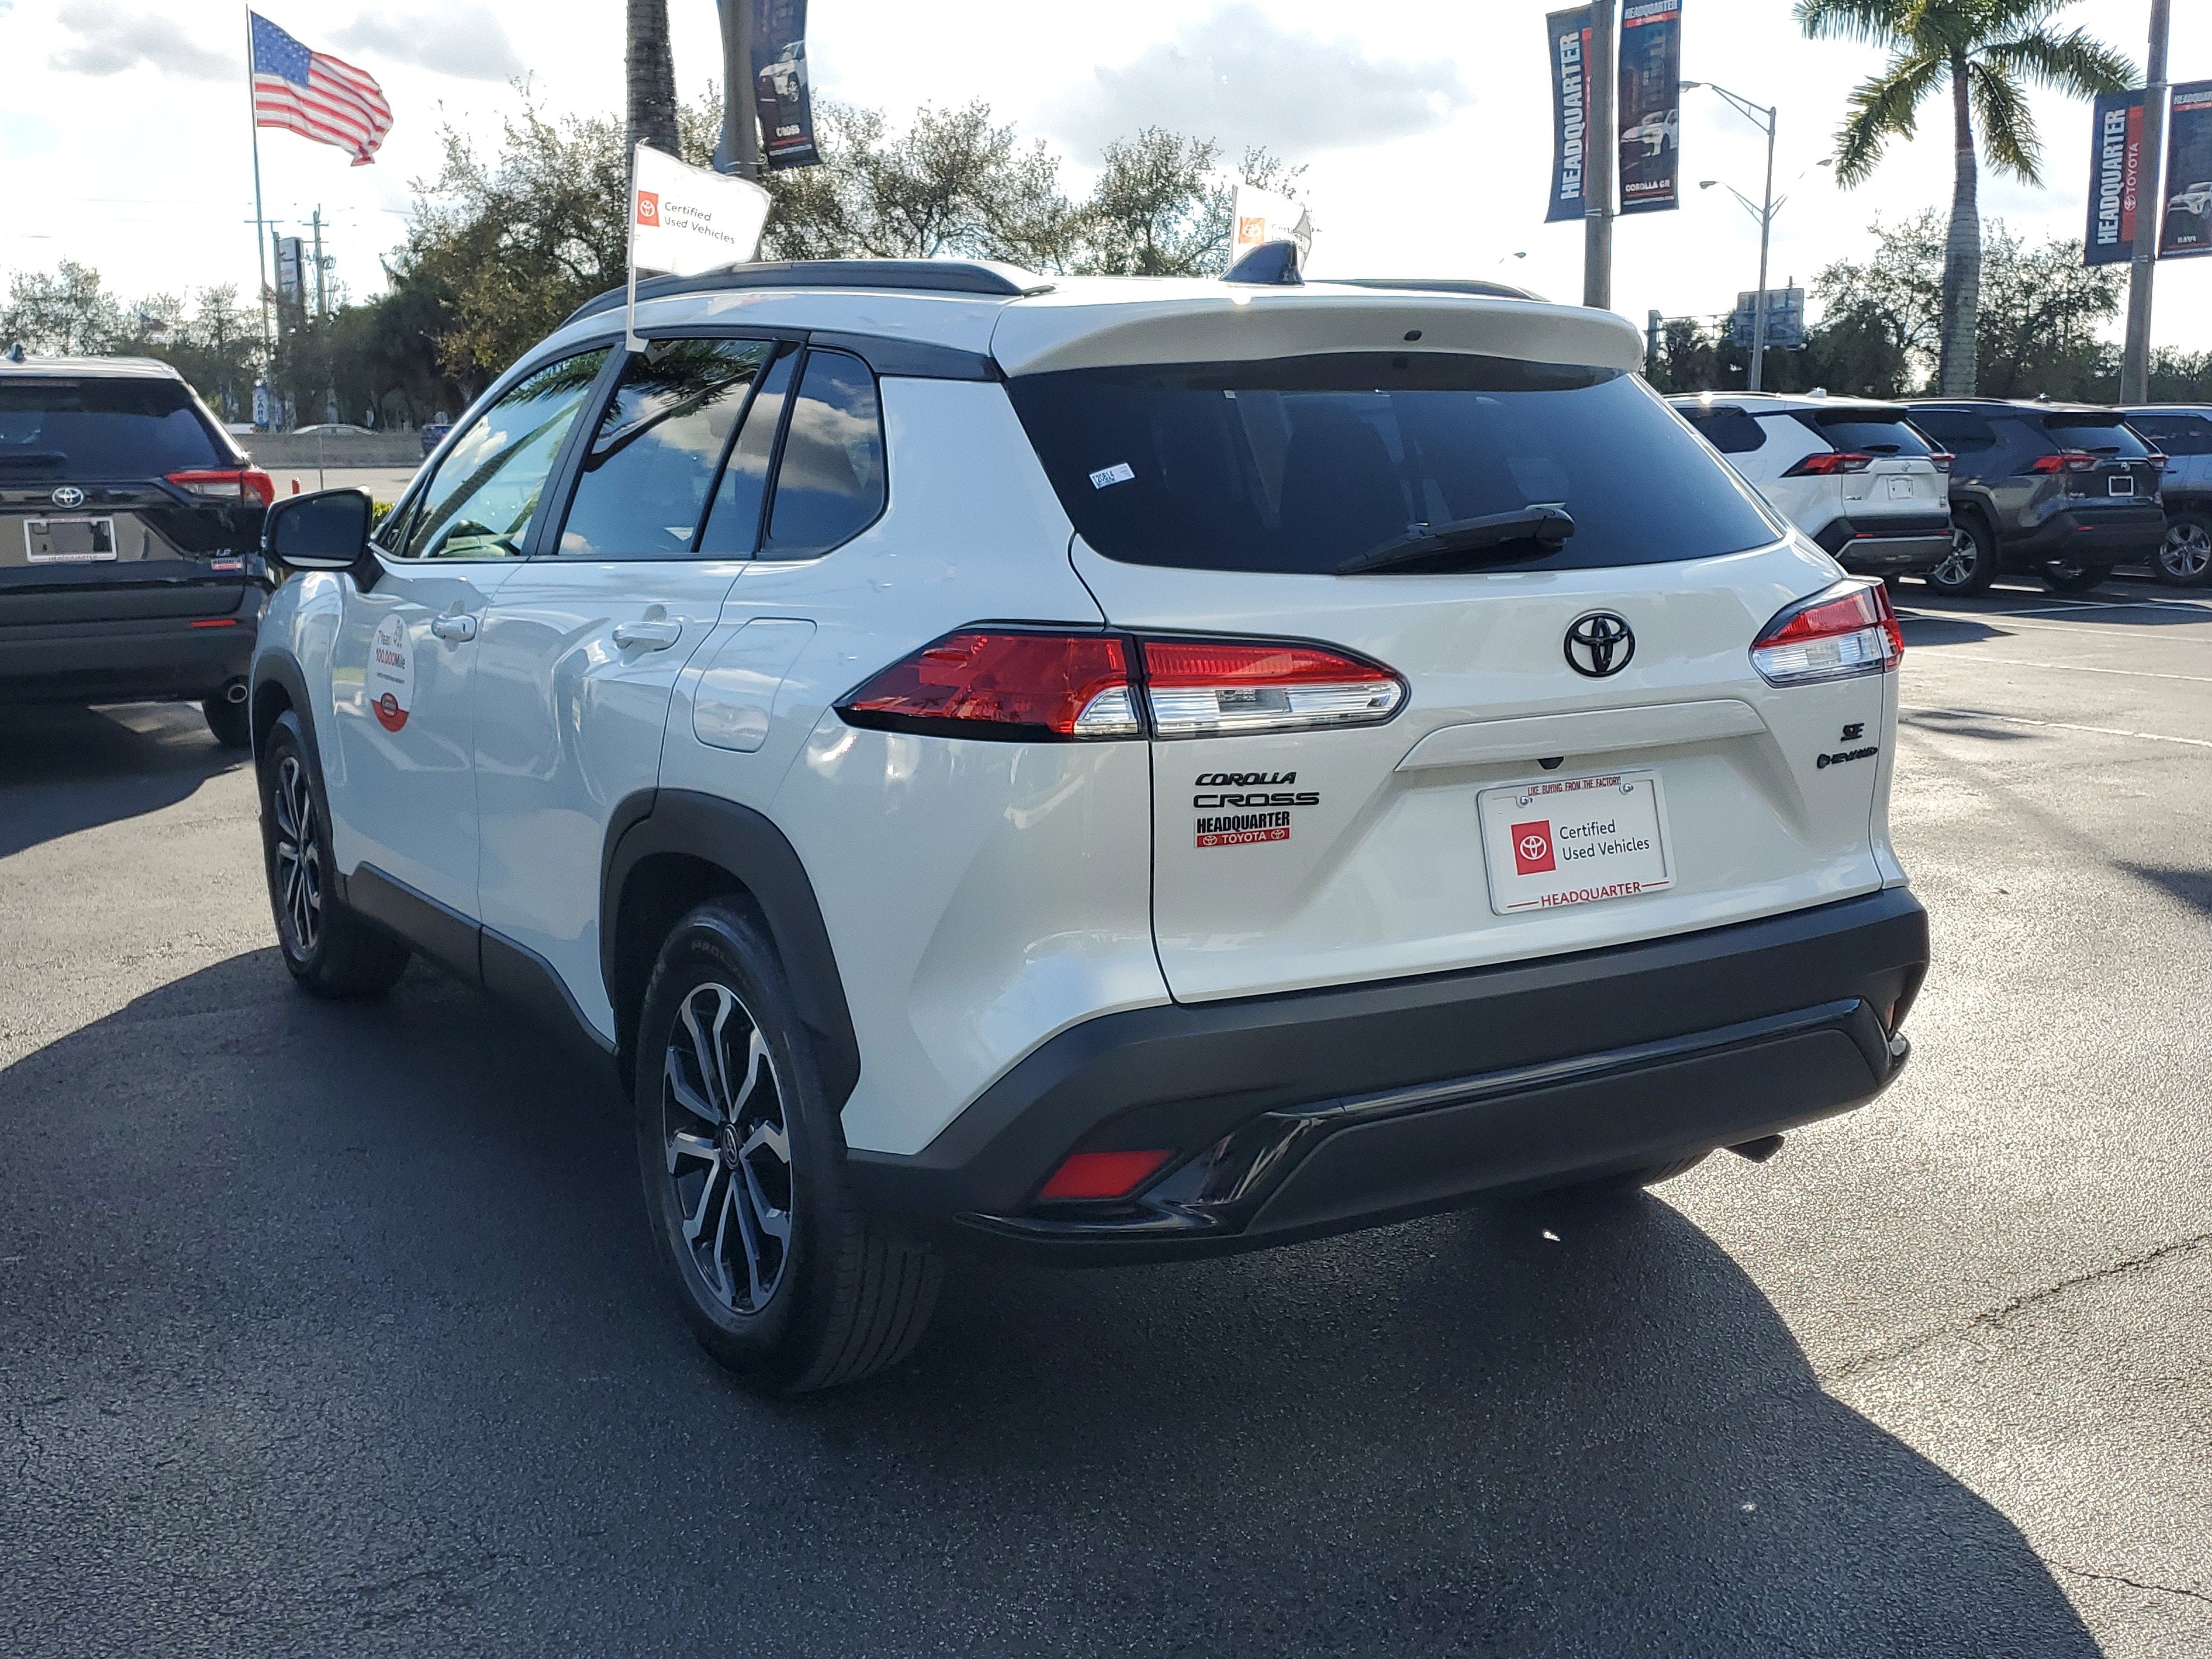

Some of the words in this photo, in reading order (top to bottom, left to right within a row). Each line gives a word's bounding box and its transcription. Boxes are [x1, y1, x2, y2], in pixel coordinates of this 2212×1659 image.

[1560, 31, 1585, 200] HEADQUARTER
[2097, 109, 2125, 245] HEADQUARTER
[2126, 143, 2139, 194] TOYOTA
[665, 202, 712, 221] Certified
[664, 216, 688, 228] Used
[692, 222, 735, 244] Vehicles
[1195, 772, 1297, 787] COROLLA
[1528, 786, 1539, 796] LIKE
[1542, 783, 1562, 794] BUYING
[1565, 780, 1581, 792] FROM
[1583, 779, 1593, 789] THE
[1596, 776, 1621, 788] FACTORY!
[1193, 792, 1320, 808] CROSS
[1197, 811, 1290, 833] HEADQUARTER
[1559, 819, 1616, 840] Certified
[1221, 832, 1267, 844] TOYOTA
[1562, 843, 1595, 861] Used
[1598, 837, 1650, 856] Vehicles
[1541, 881, 1642, 907] HEADQUARTER
